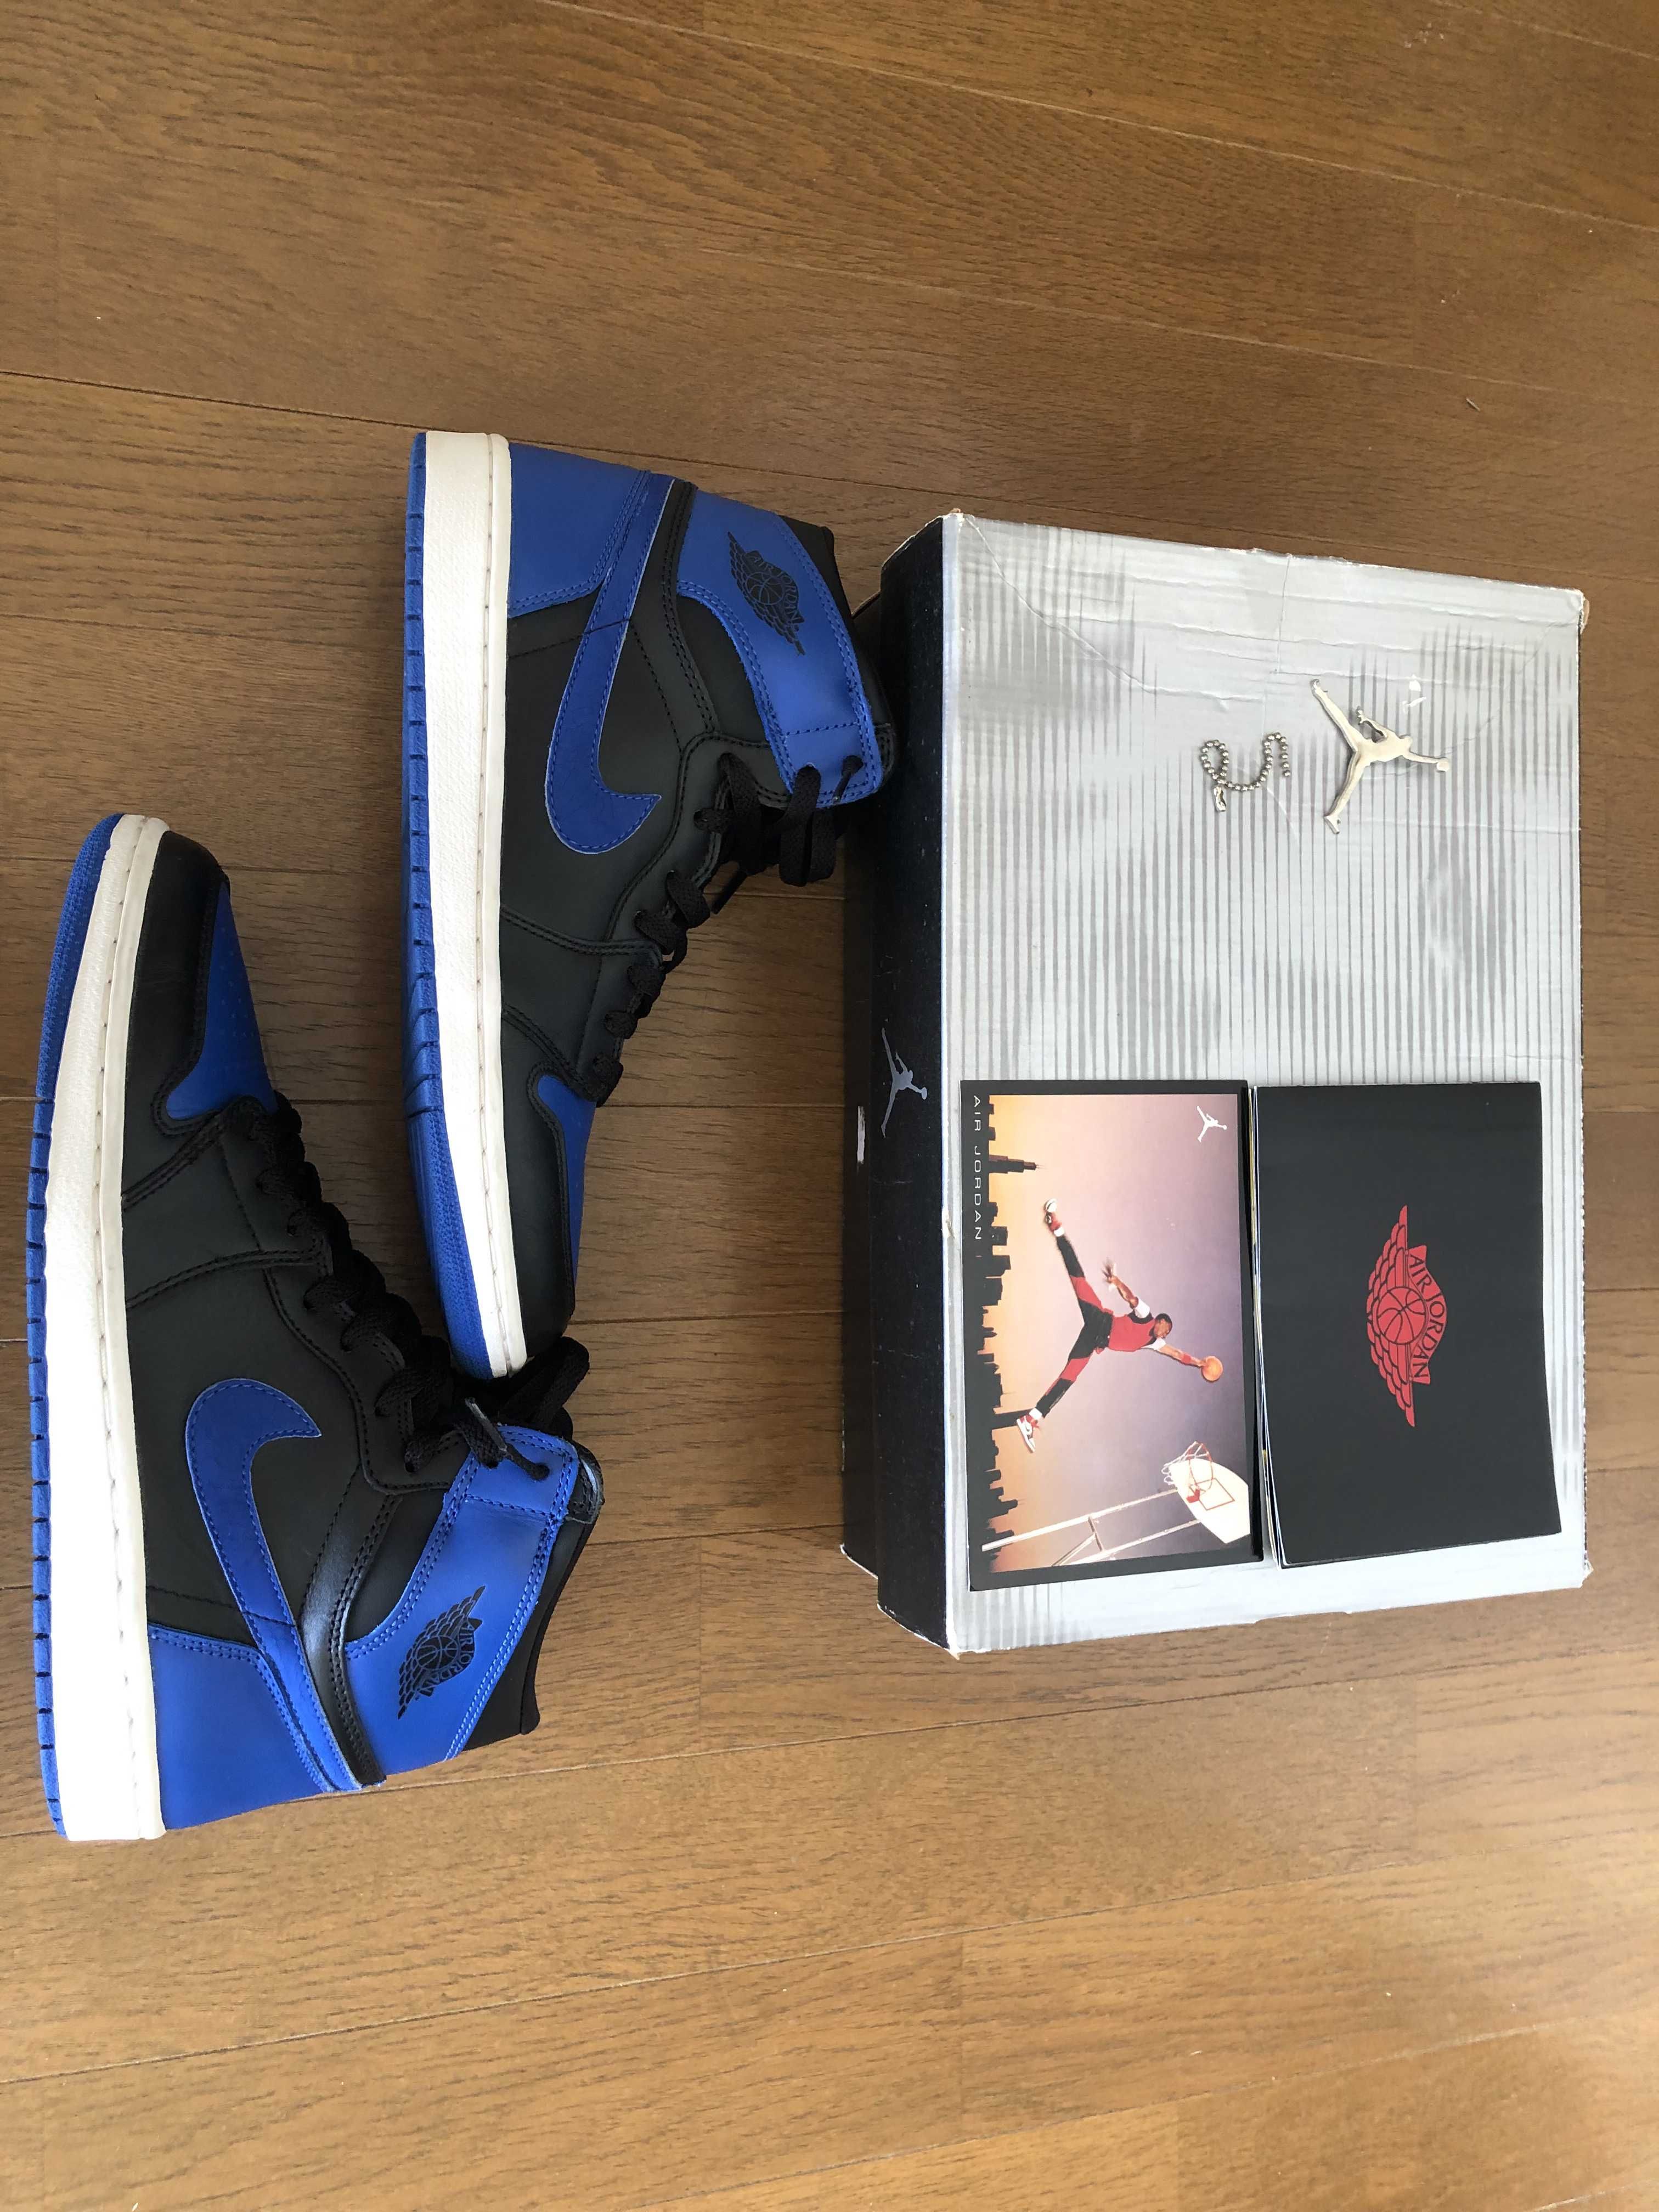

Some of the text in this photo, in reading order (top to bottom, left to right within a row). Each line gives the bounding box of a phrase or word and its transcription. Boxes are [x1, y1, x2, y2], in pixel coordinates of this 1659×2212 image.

[776, 571, 802, 622] JORDAN
[974, 1146, 982, 1240] JORDAN
[1409, 1254, 1445, 1378] AIR JORDAN
[419, 1620, 474, 1694] AIR JORDAN
